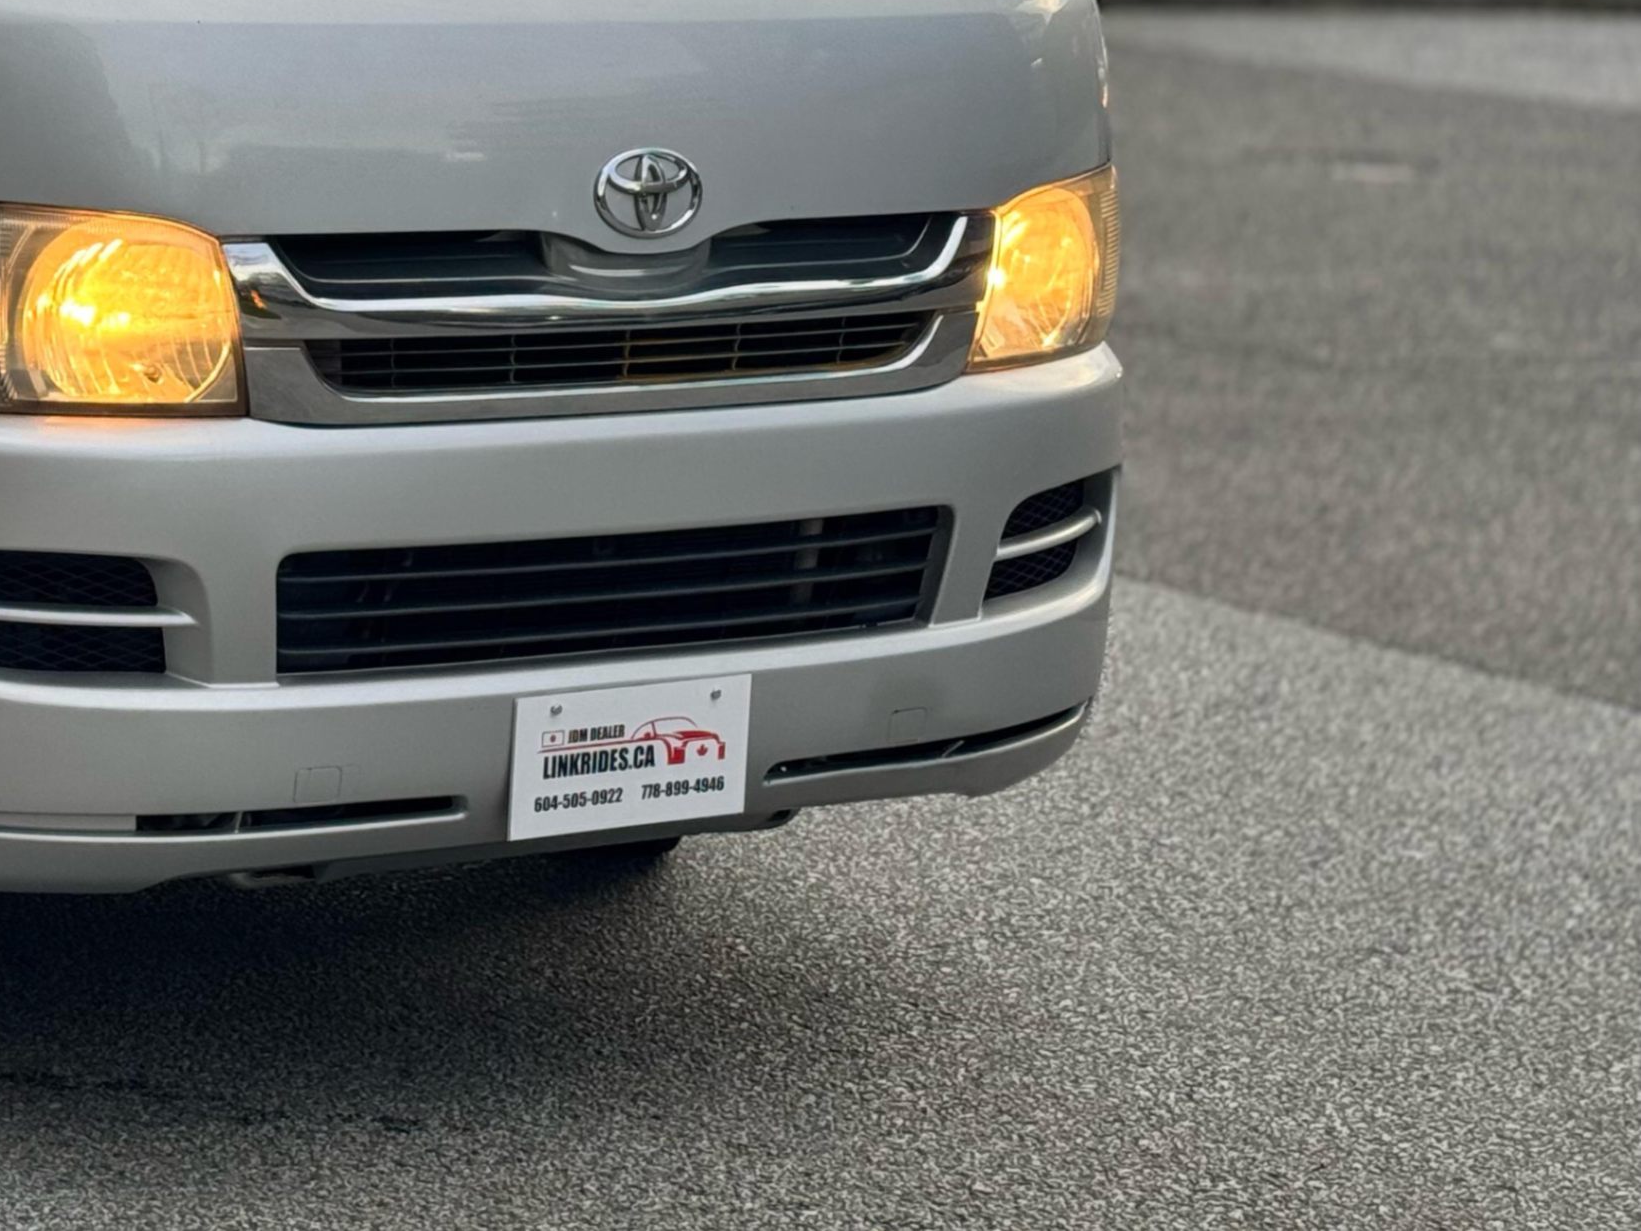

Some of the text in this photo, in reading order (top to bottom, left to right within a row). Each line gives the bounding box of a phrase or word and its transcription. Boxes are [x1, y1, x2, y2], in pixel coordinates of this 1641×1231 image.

[568, 724, 626, 744] JDM DEALER
[542, 744, 656, 780] LINKRIDES.CA
[534, 775, 725, 813] 604-505-0922 778-899-4946
